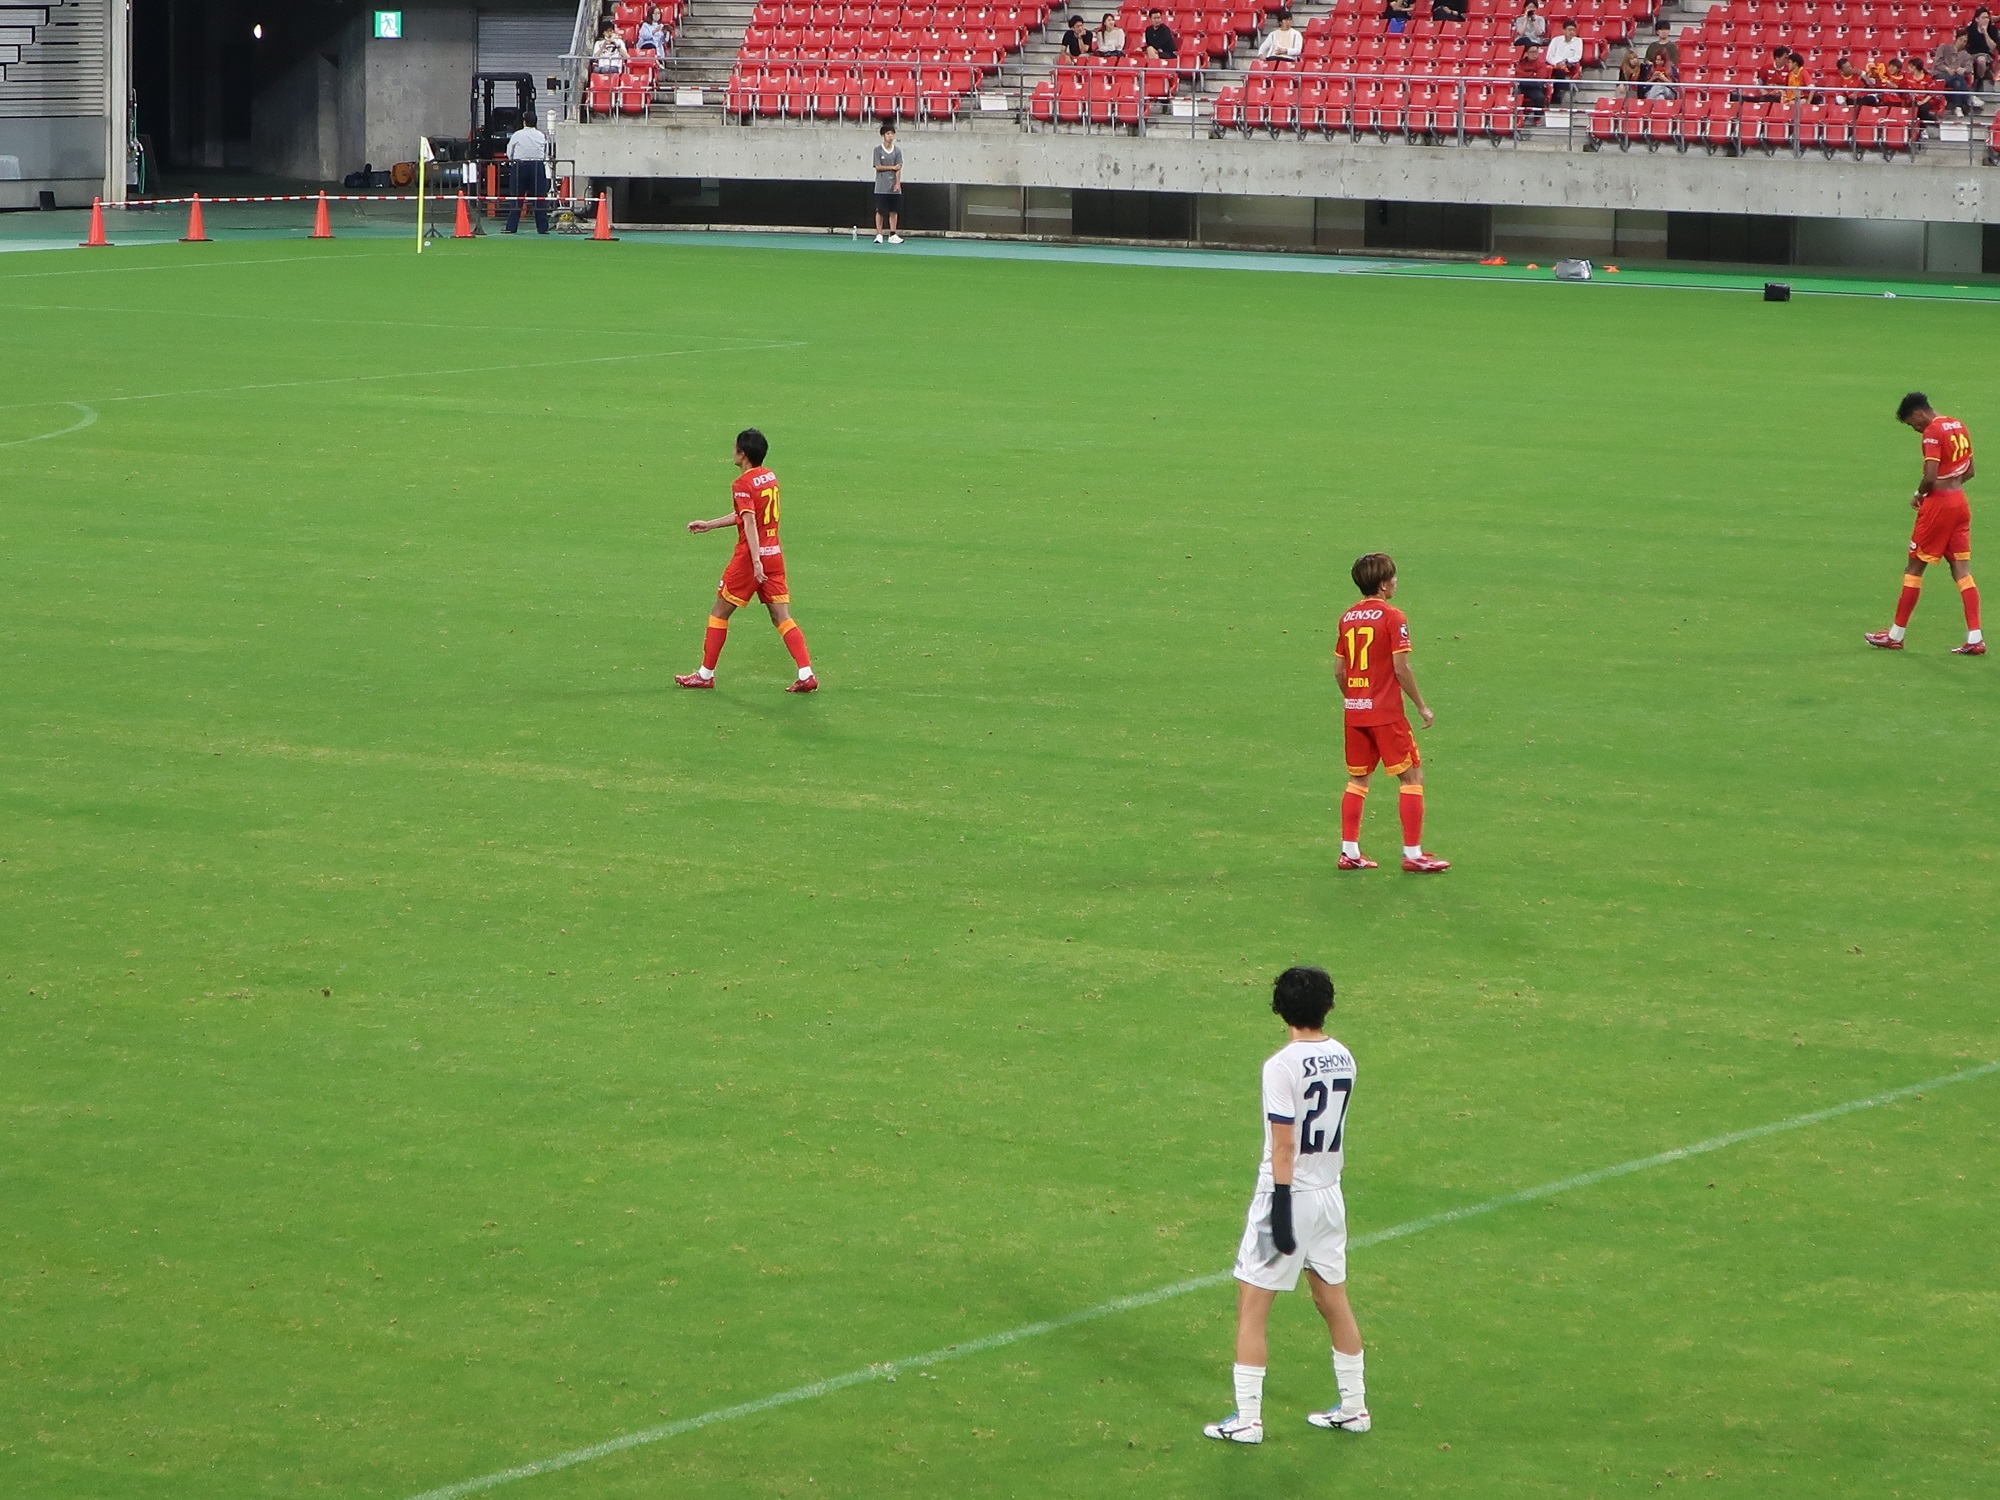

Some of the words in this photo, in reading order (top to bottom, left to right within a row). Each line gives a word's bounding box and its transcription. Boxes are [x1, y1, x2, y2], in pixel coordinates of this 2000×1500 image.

[1343, 609, 1384, 623] DENSO
[1344, 626, 1375, 671] 17
[1300, 1078, 1353, 1155] 27
